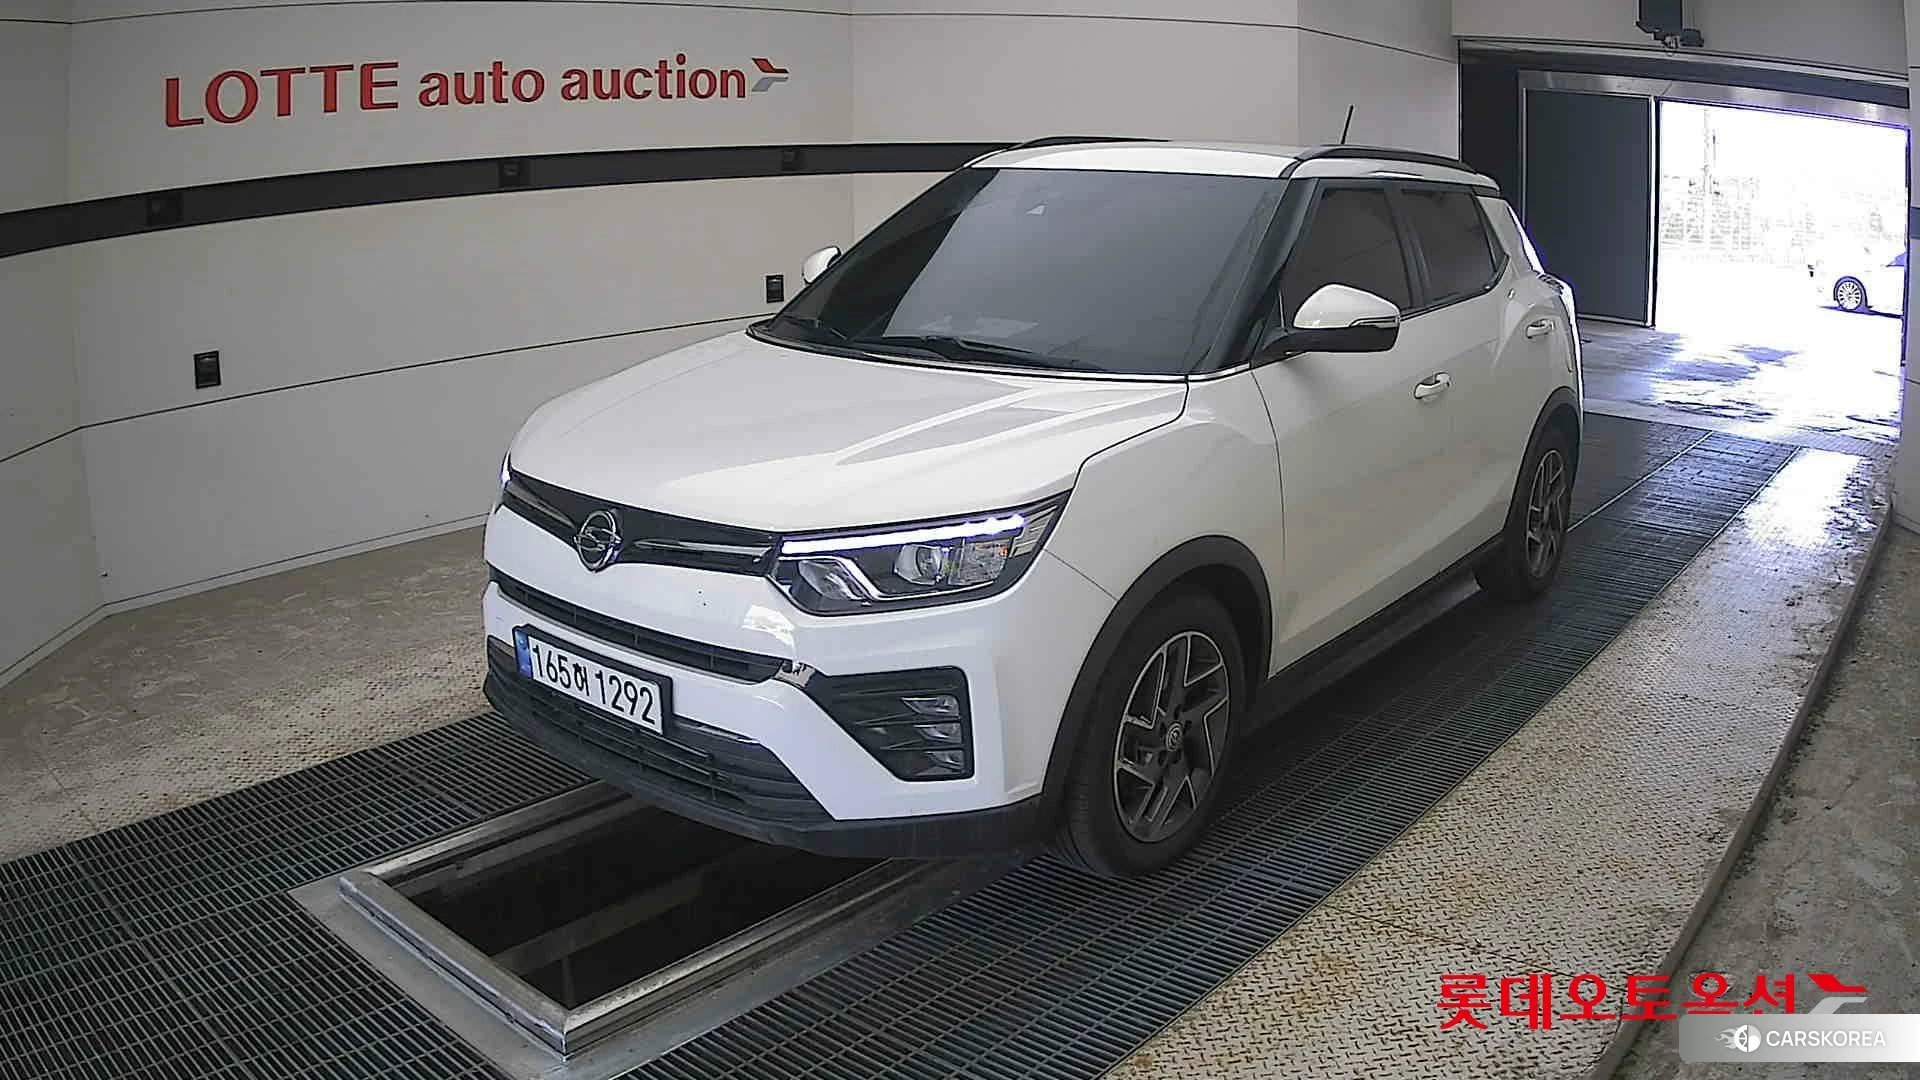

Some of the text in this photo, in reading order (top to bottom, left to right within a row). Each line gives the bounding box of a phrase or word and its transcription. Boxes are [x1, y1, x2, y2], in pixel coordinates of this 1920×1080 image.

[164, 53, 747, 128] LOTTE auto auction
[595, 670, 656, 725] 1292
